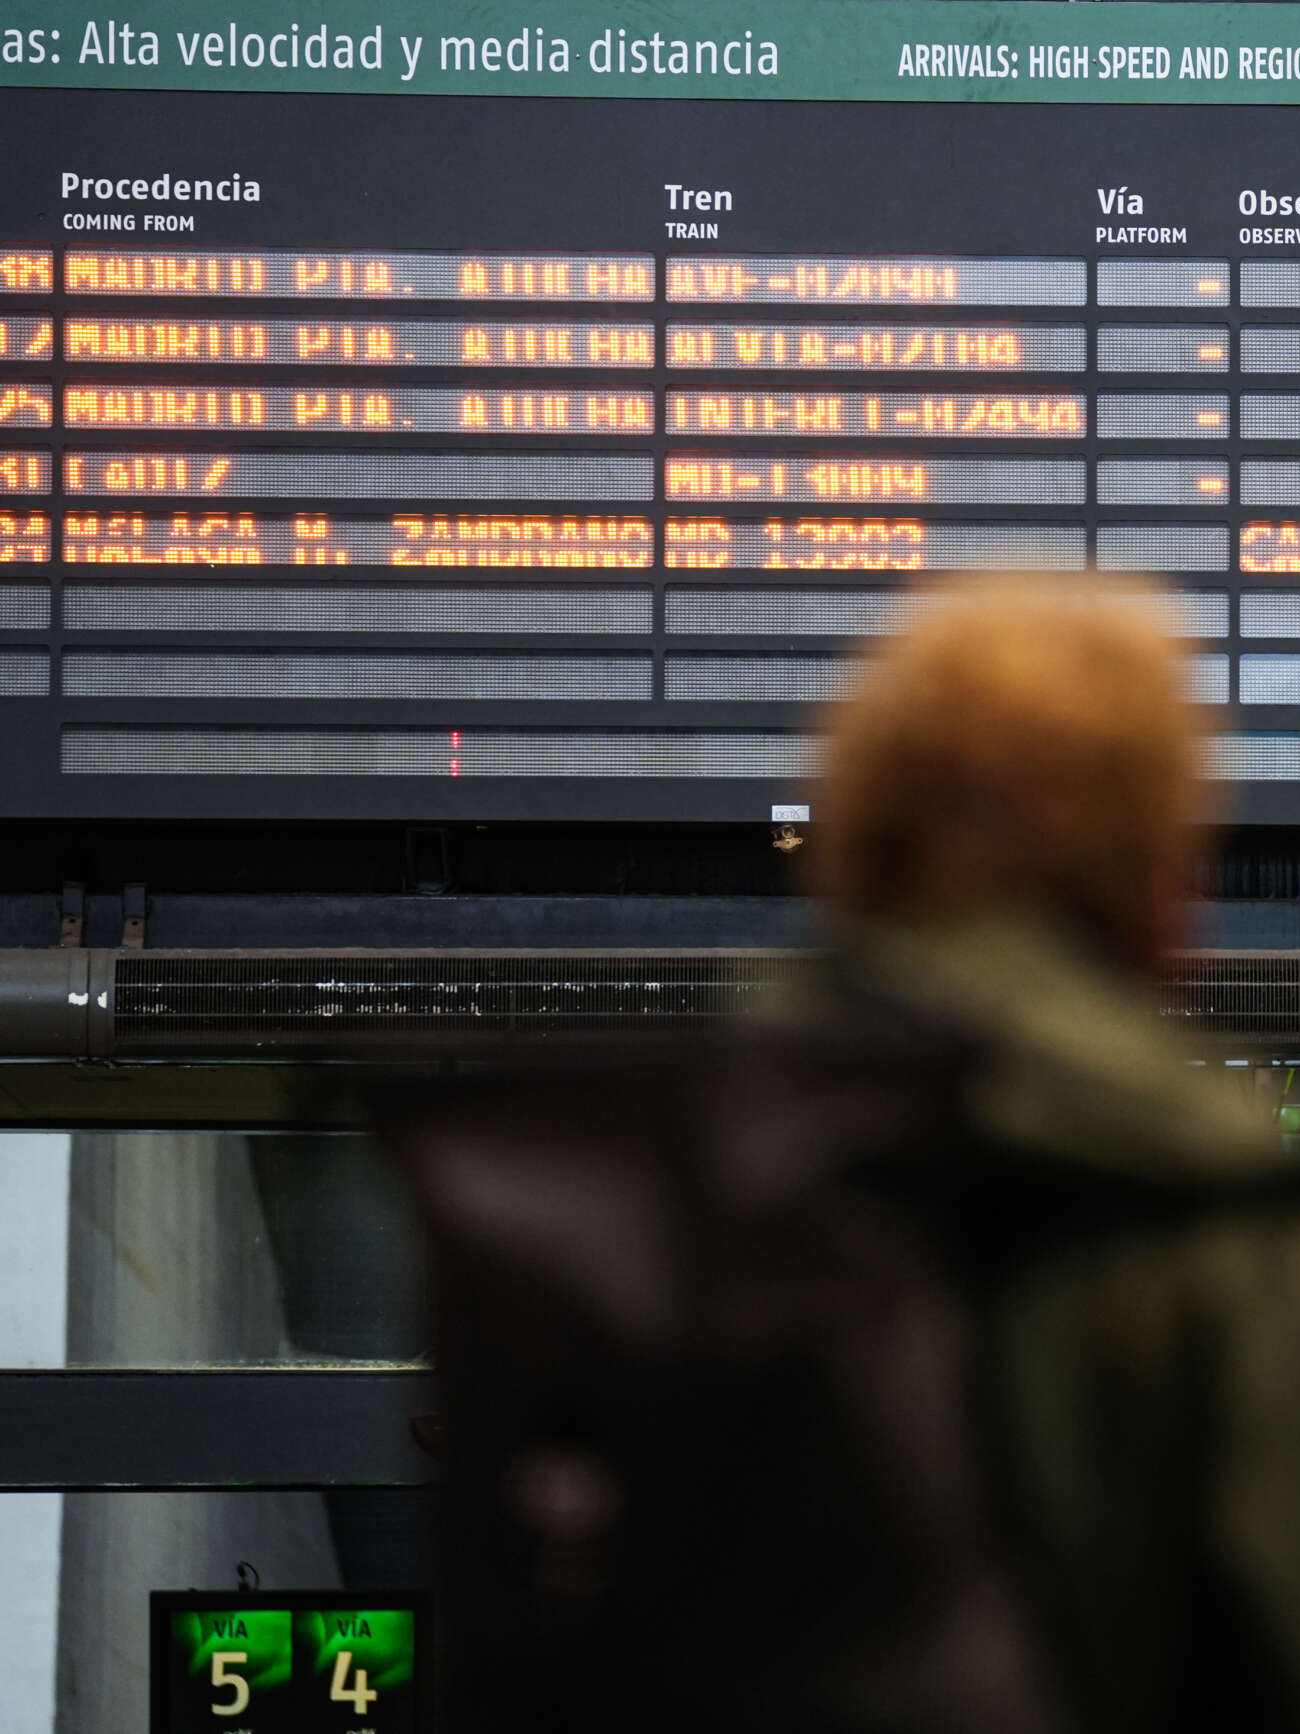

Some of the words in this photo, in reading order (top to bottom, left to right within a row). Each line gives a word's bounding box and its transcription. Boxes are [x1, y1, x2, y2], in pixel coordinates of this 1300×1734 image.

[3, 30, 59, 63] as:
[79, 21, 158, 65] Alta
[177, 23, 381, 69] velocidad
[401, 37, 422, 80] y
[441, 28, 568, 72] media
[590, 29, 777, 75] distancia
[898, 44, 1018, 78] ARRIVALS:
[1030, 46, 1088, 78] HIGH
[1099, 46, 1170, 79] SPEED
[1179, 47, 1228, 79] AND
[63, 173, 259, 201] Procedencia
[665, 185, 731, 210] Tren
[1098, 187, 1143, 214] Vía
[64, 214, 134, 230] COMING
[145, 216, 193, 231] FROM
[666, 223, 717, 238] TRAIN
[1097, 228, 1186, 243] PLATFORM
[211, 1651, 250, 1716] 5
[330, 1651, 377, 1715] 4
